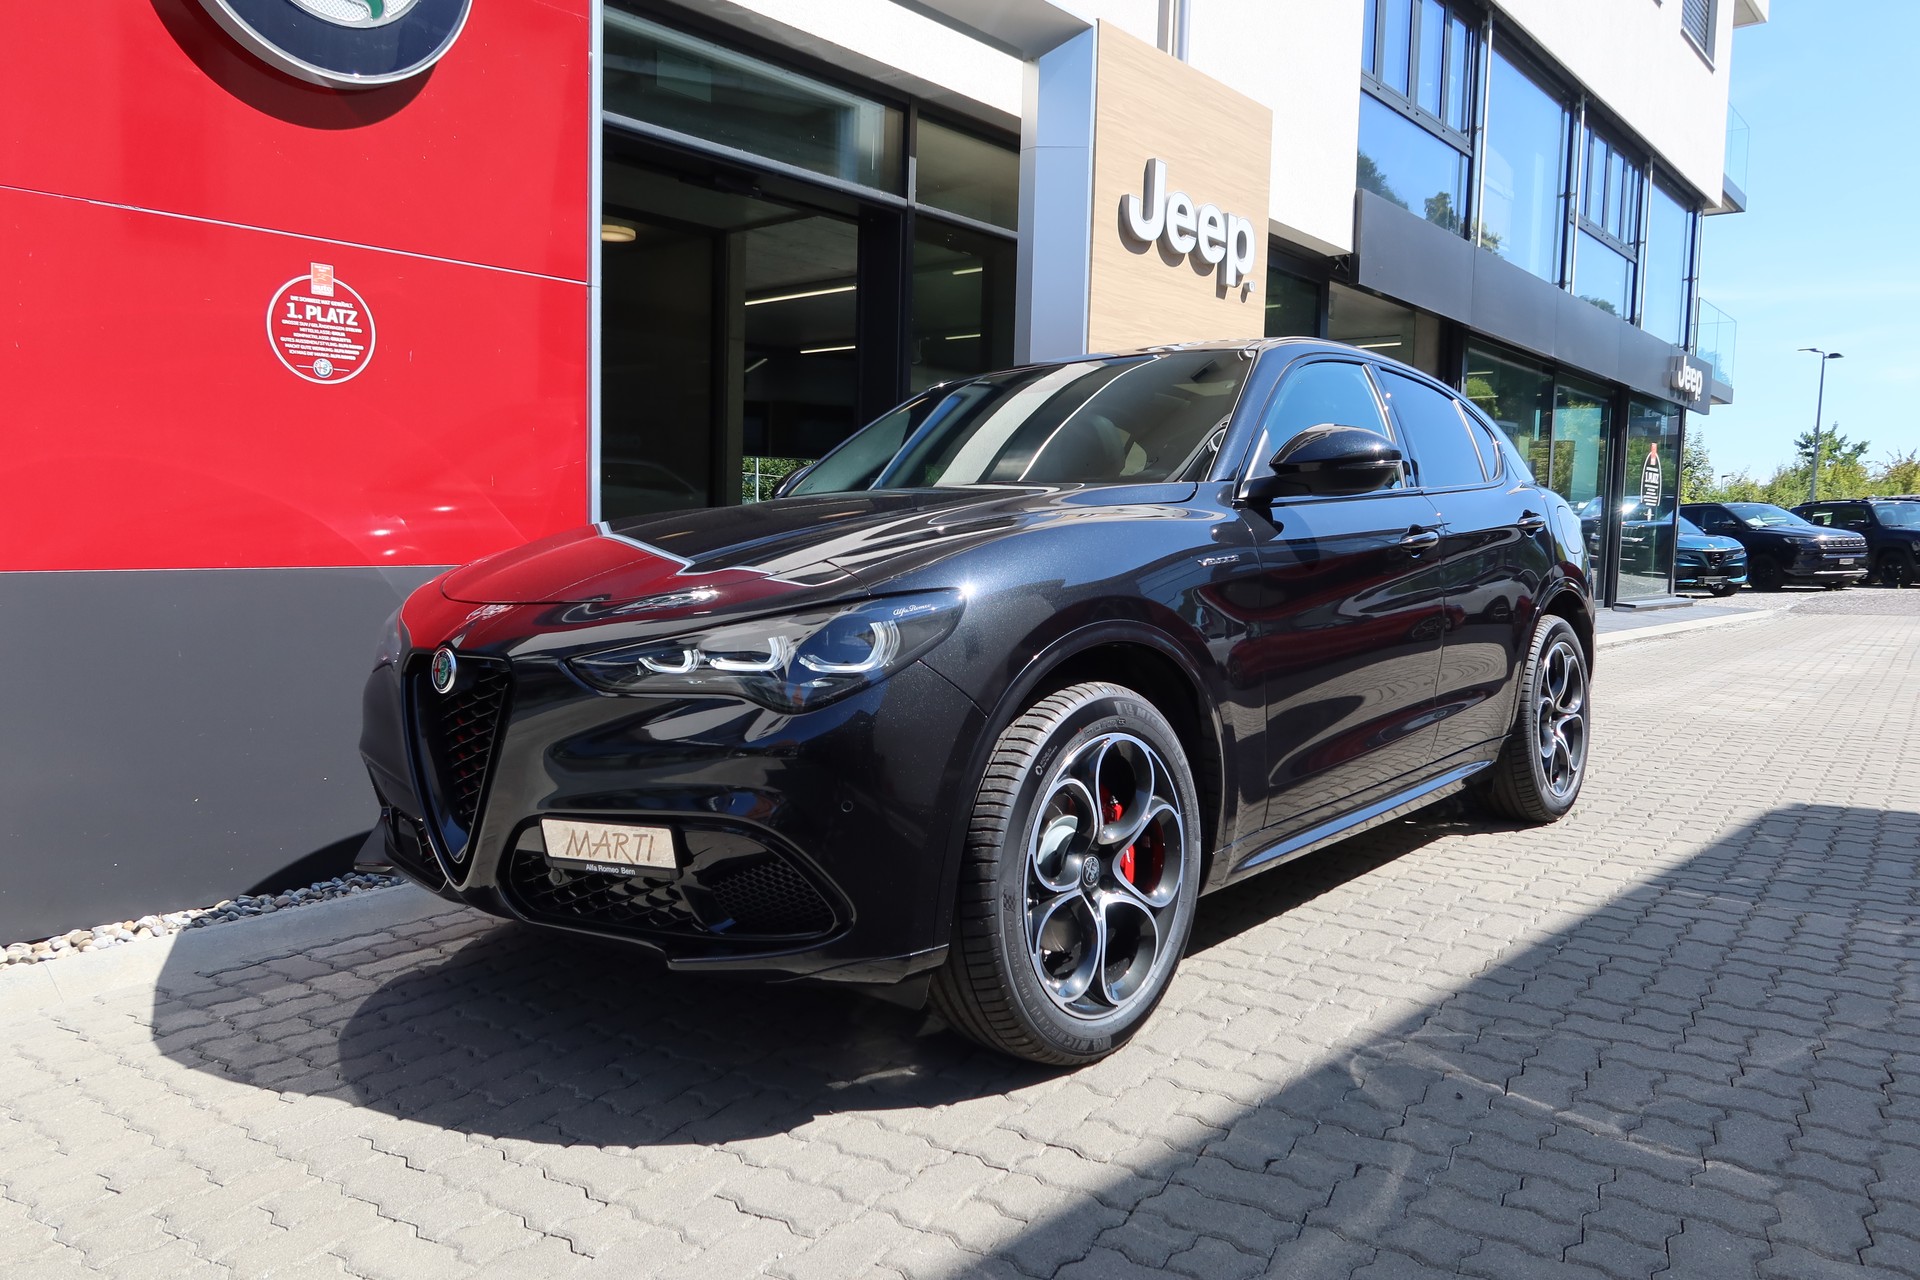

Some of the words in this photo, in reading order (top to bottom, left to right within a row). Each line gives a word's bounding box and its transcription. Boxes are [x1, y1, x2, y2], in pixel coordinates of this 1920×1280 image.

[1120, 157, 1256, 287] Jeep
[286, 302, 303, 319] 1.
[306, 304, 358, 326] PLATZ
[1677, 355, 1703, 400] Jeep
[565, 829, 655, 864] MARTI
[585, 863, 598, 872] Alfa
[598, 865, 619, 874] Romeo
[621, 867, 636, 876] Bern
